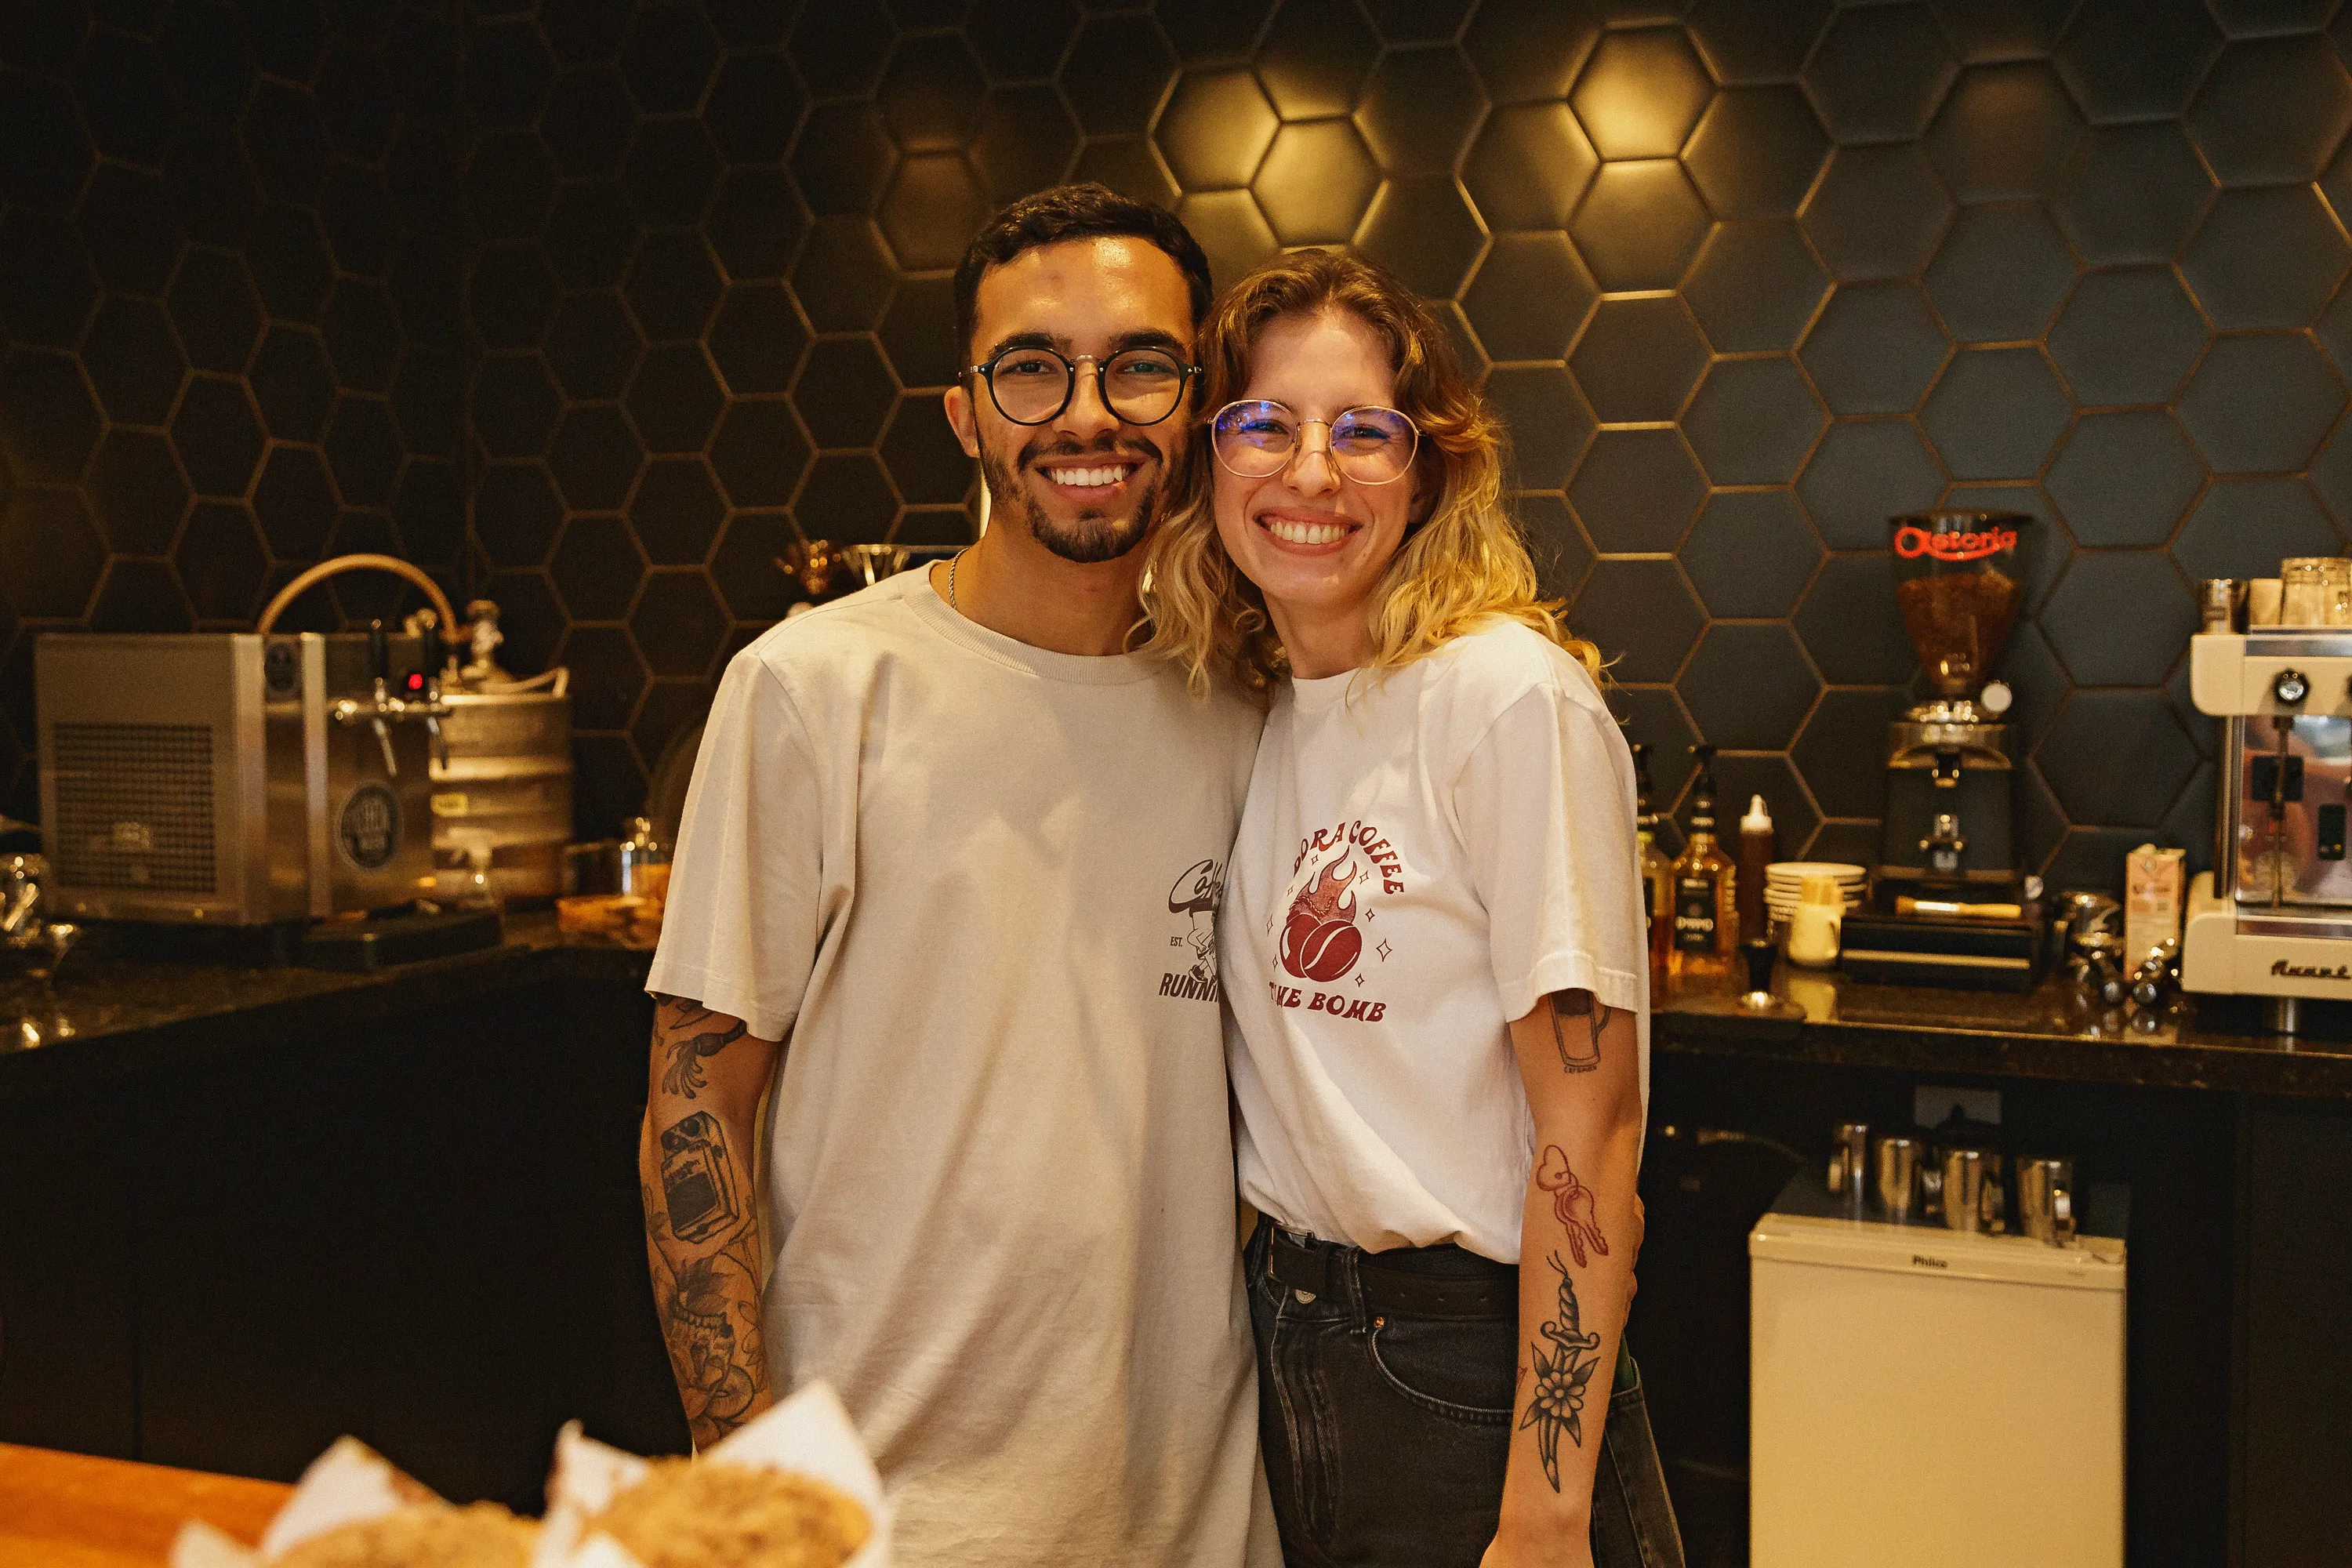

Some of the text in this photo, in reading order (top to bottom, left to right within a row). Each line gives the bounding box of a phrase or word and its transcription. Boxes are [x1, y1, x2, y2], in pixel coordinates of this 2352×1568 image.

[1348, 820, 1404, 895] COFFEE
[1171, 936, 1183, 947] EST.
[1308, 992, 1387, 1022] BOMB
